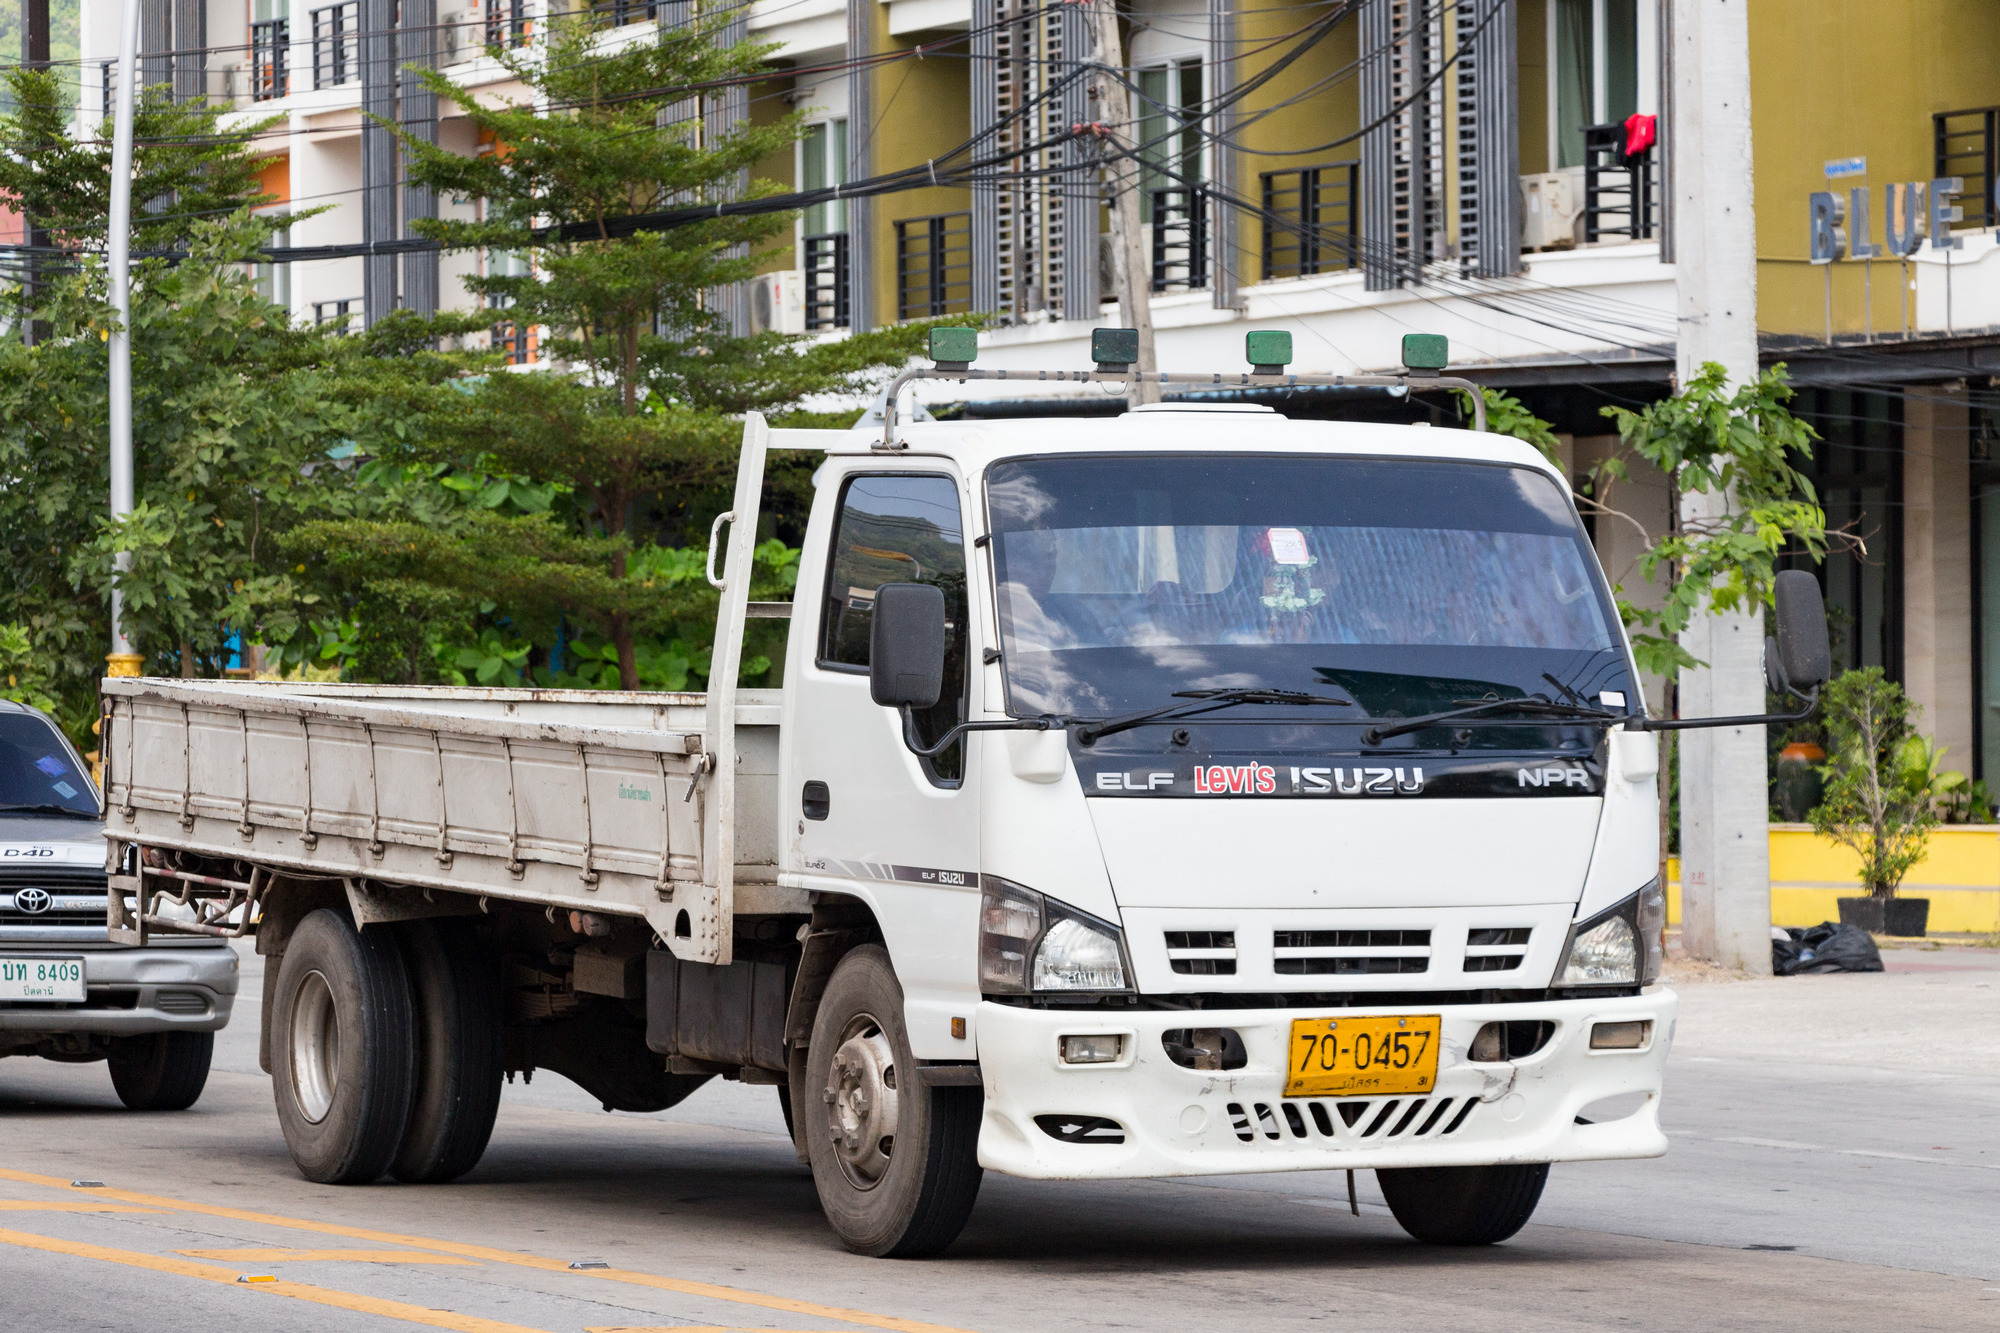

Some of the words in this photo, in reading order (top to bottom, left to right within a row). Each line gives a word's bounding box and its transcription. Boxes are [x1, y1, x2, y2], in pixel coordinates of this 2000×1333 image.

[1810, 177, 1964, 265] BLUE
[1096, 772, 1175, 790] ELF
[1290, 767, 1424, 794] ISUZU
[1518, 768, 1589, 787] NPR
[922, 872, 936, 880] ELF
[938, 871, 965, 885] ISUZU
[3, 963, 27, 981] บท
[37, 964, 79, 981] 8409
[1300, 1030, 1431, 1072] 70-0457
